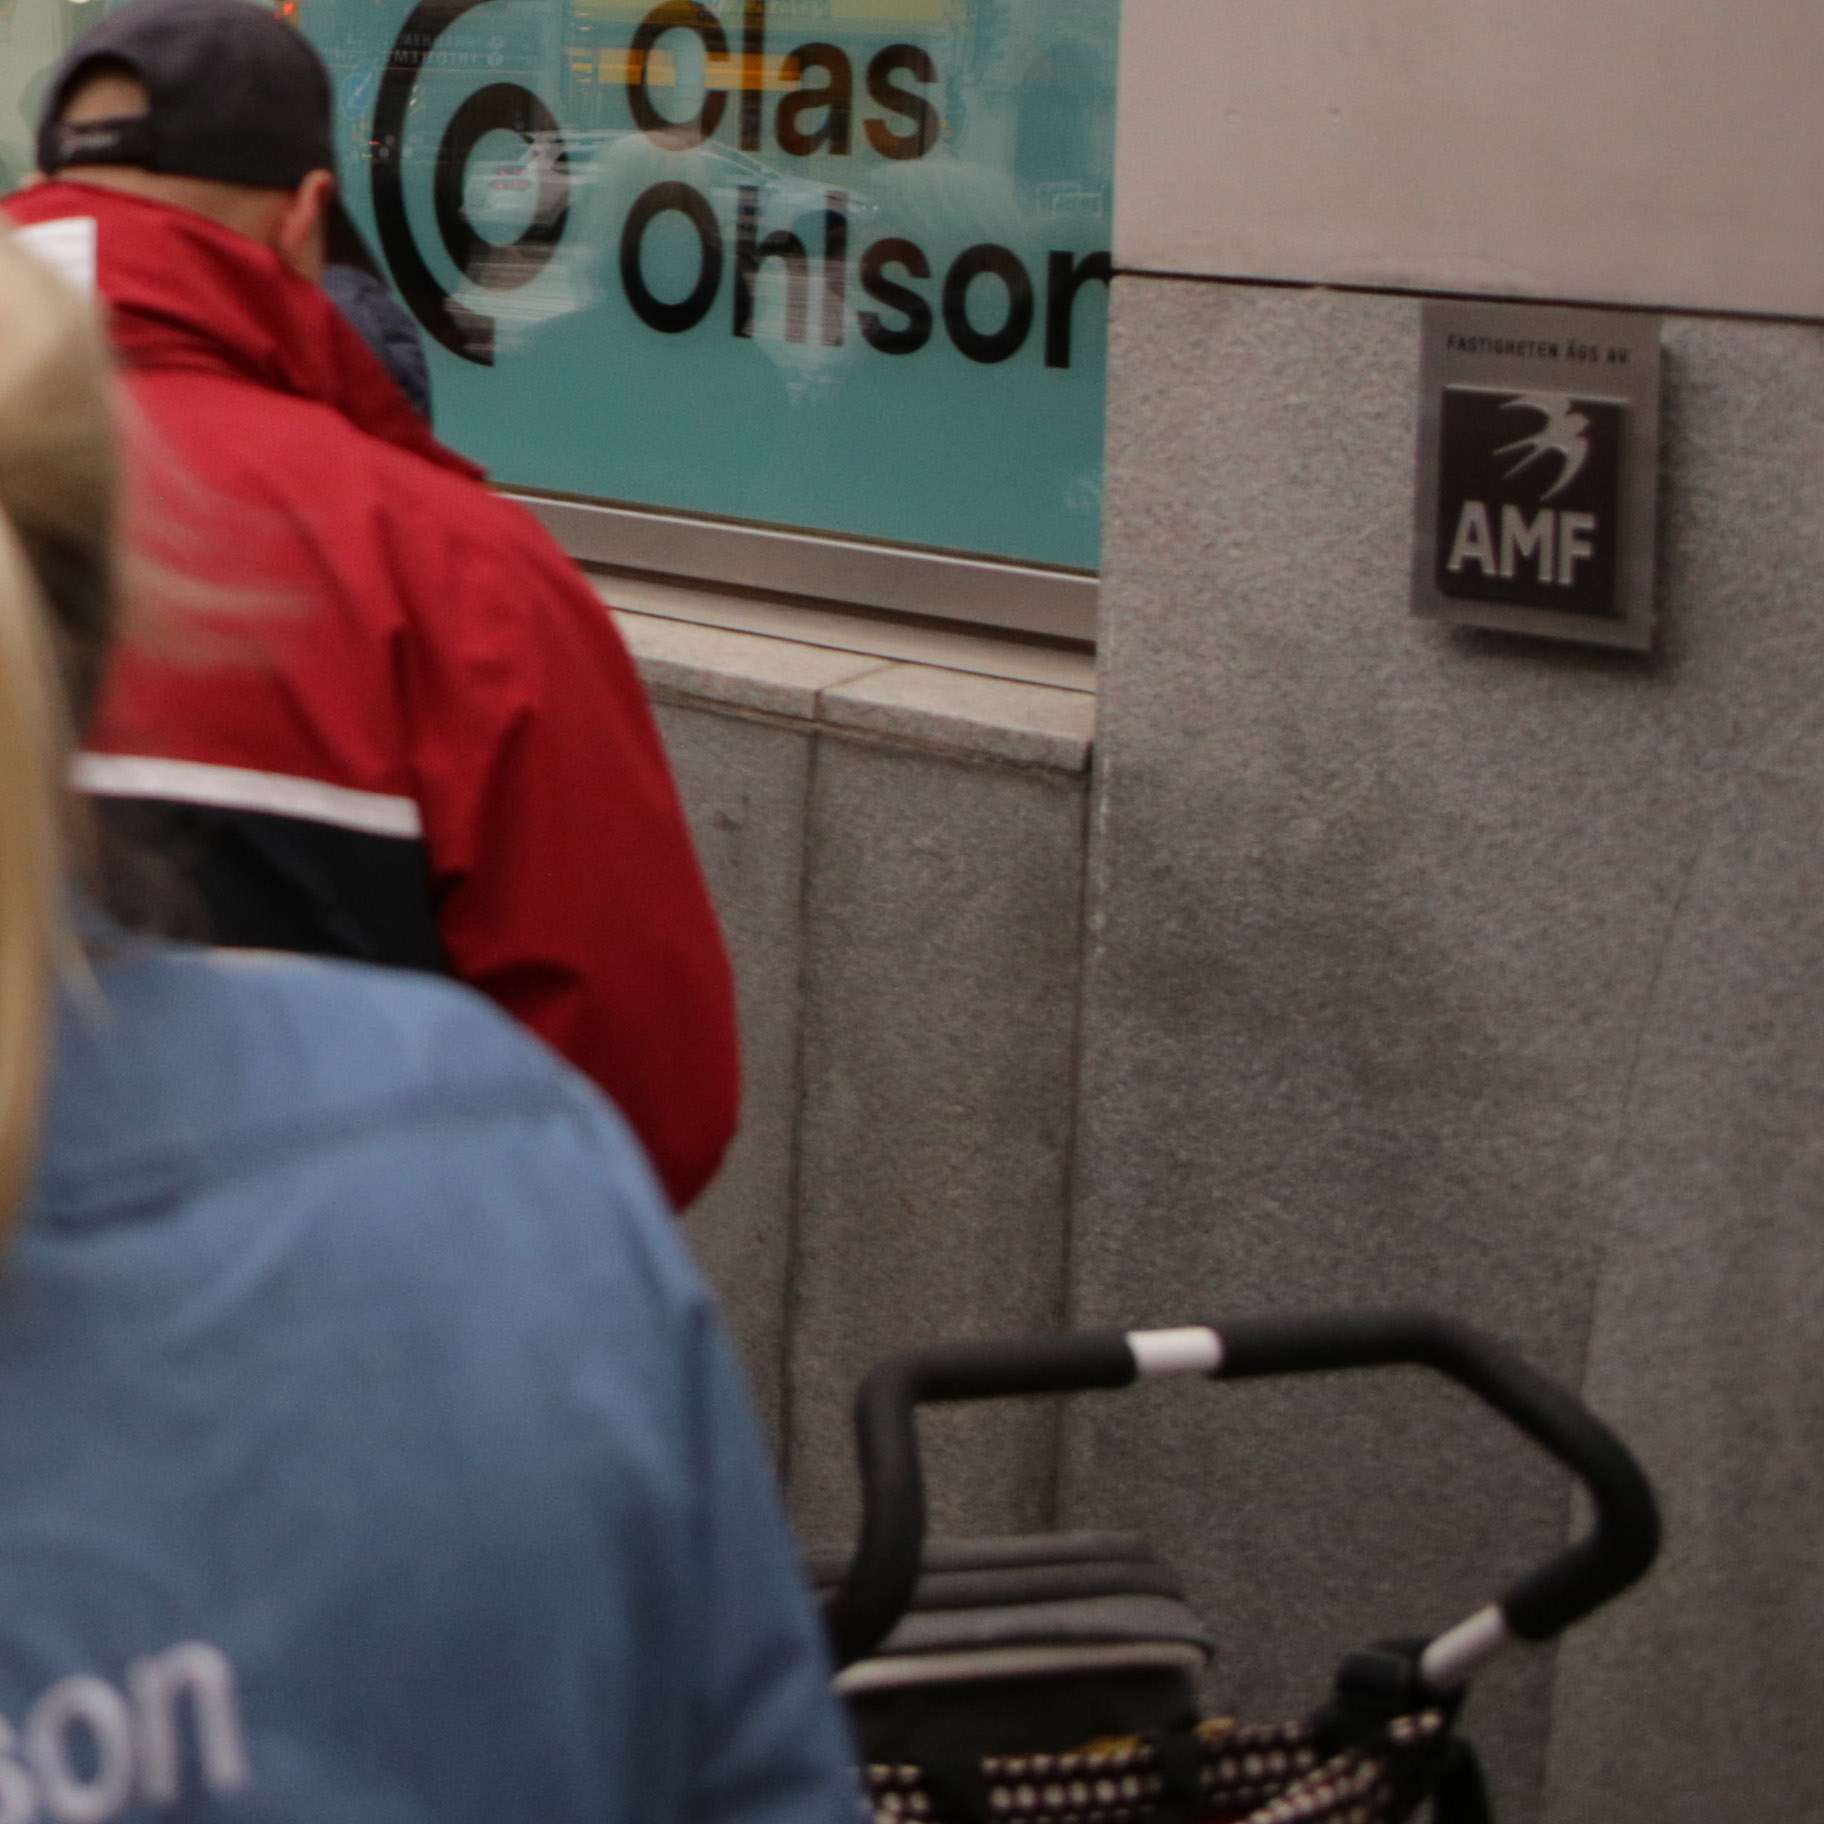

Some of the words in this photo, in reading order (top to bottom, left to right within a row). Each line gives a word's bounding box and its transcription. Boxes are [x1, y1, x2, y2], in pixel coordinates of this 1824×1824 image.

[1446, 333, 1558, 359] FASTIGHETEN
[1566, 341, 1599, 364] ÄGS
[1606, 347, 1631, 365] AV
[1448, 500, 1596, 585] AMF
